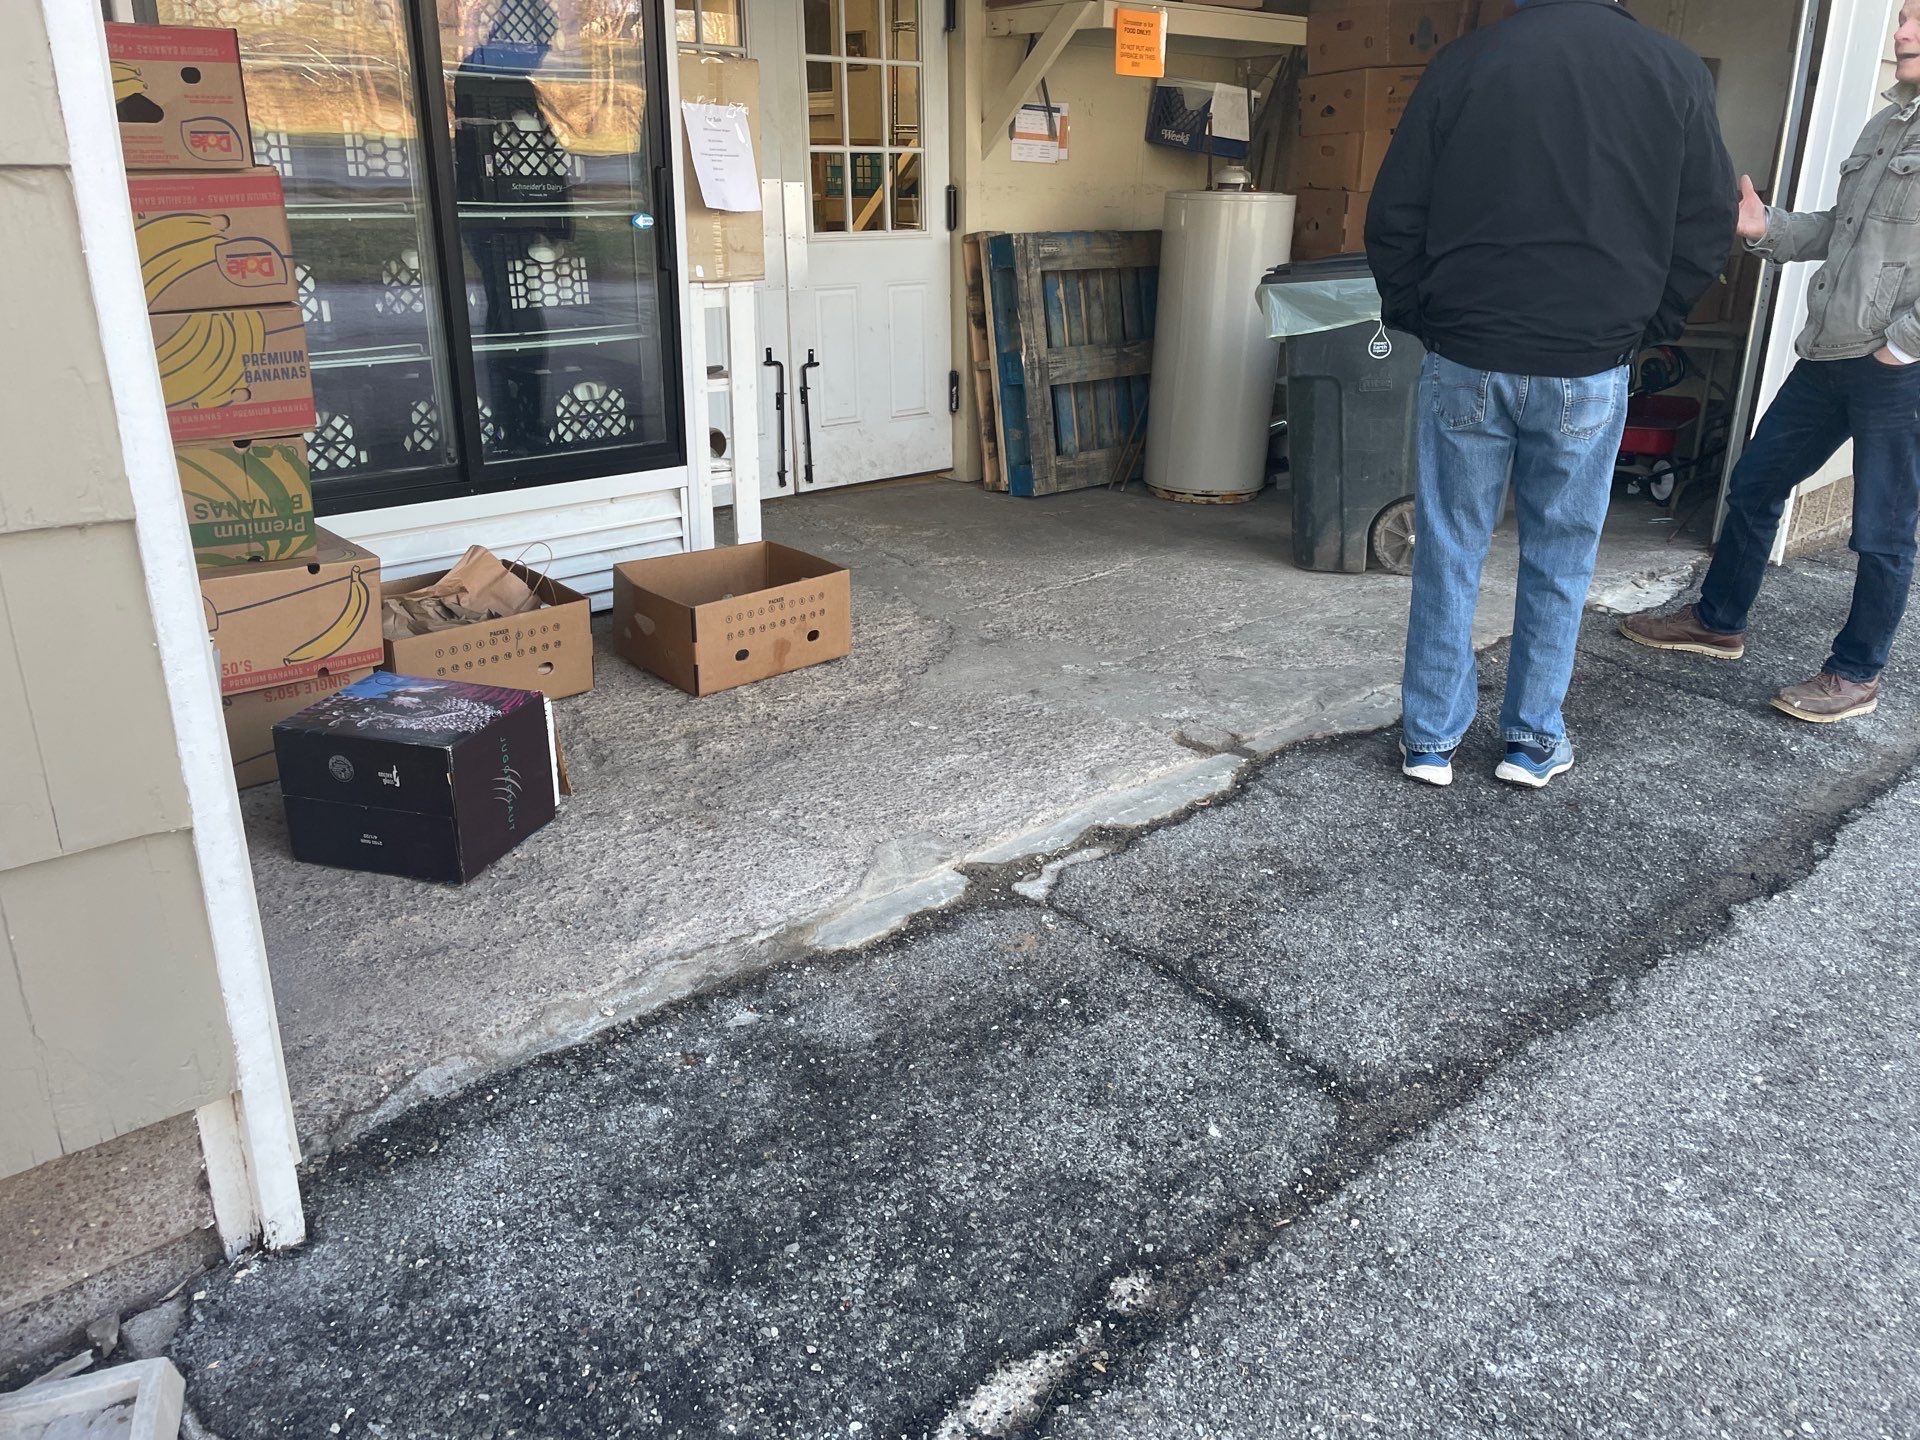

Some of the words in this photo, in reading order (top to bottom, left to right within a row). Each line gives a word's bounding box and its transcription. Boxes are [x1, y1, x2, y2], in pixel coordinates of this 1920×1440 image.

[132, 197, 156, 206] BANA
[226, 256, 275, 279] Dole
[242, 350, 304, 367] PREMIUM
[244, 366, 307, 384] BANANAS
[182, 412, 222, 424] BANANAS
[233, 406, 270, 418] PREMIUM
[272, 404, 309, 414] BANANAS
[194, 494, 304, 520] BNANAS
[214, 516, 306, 538] Premium
[490, 628, 510, 637] PACKER
[222, 660, 252, 675] 50'S
[229, 674, 266, 688] PREMIUM
[268, 668, 303, 682] BANANAS
[313, 660, 348, 673] PREMIUM
[348, 652, 380, 666] BANANAS
[264, 686, 300, 703] 150'S
[305, 674, 350, 695] SINGLE
[500, 737, 516, 830] JUGGERNAUT
